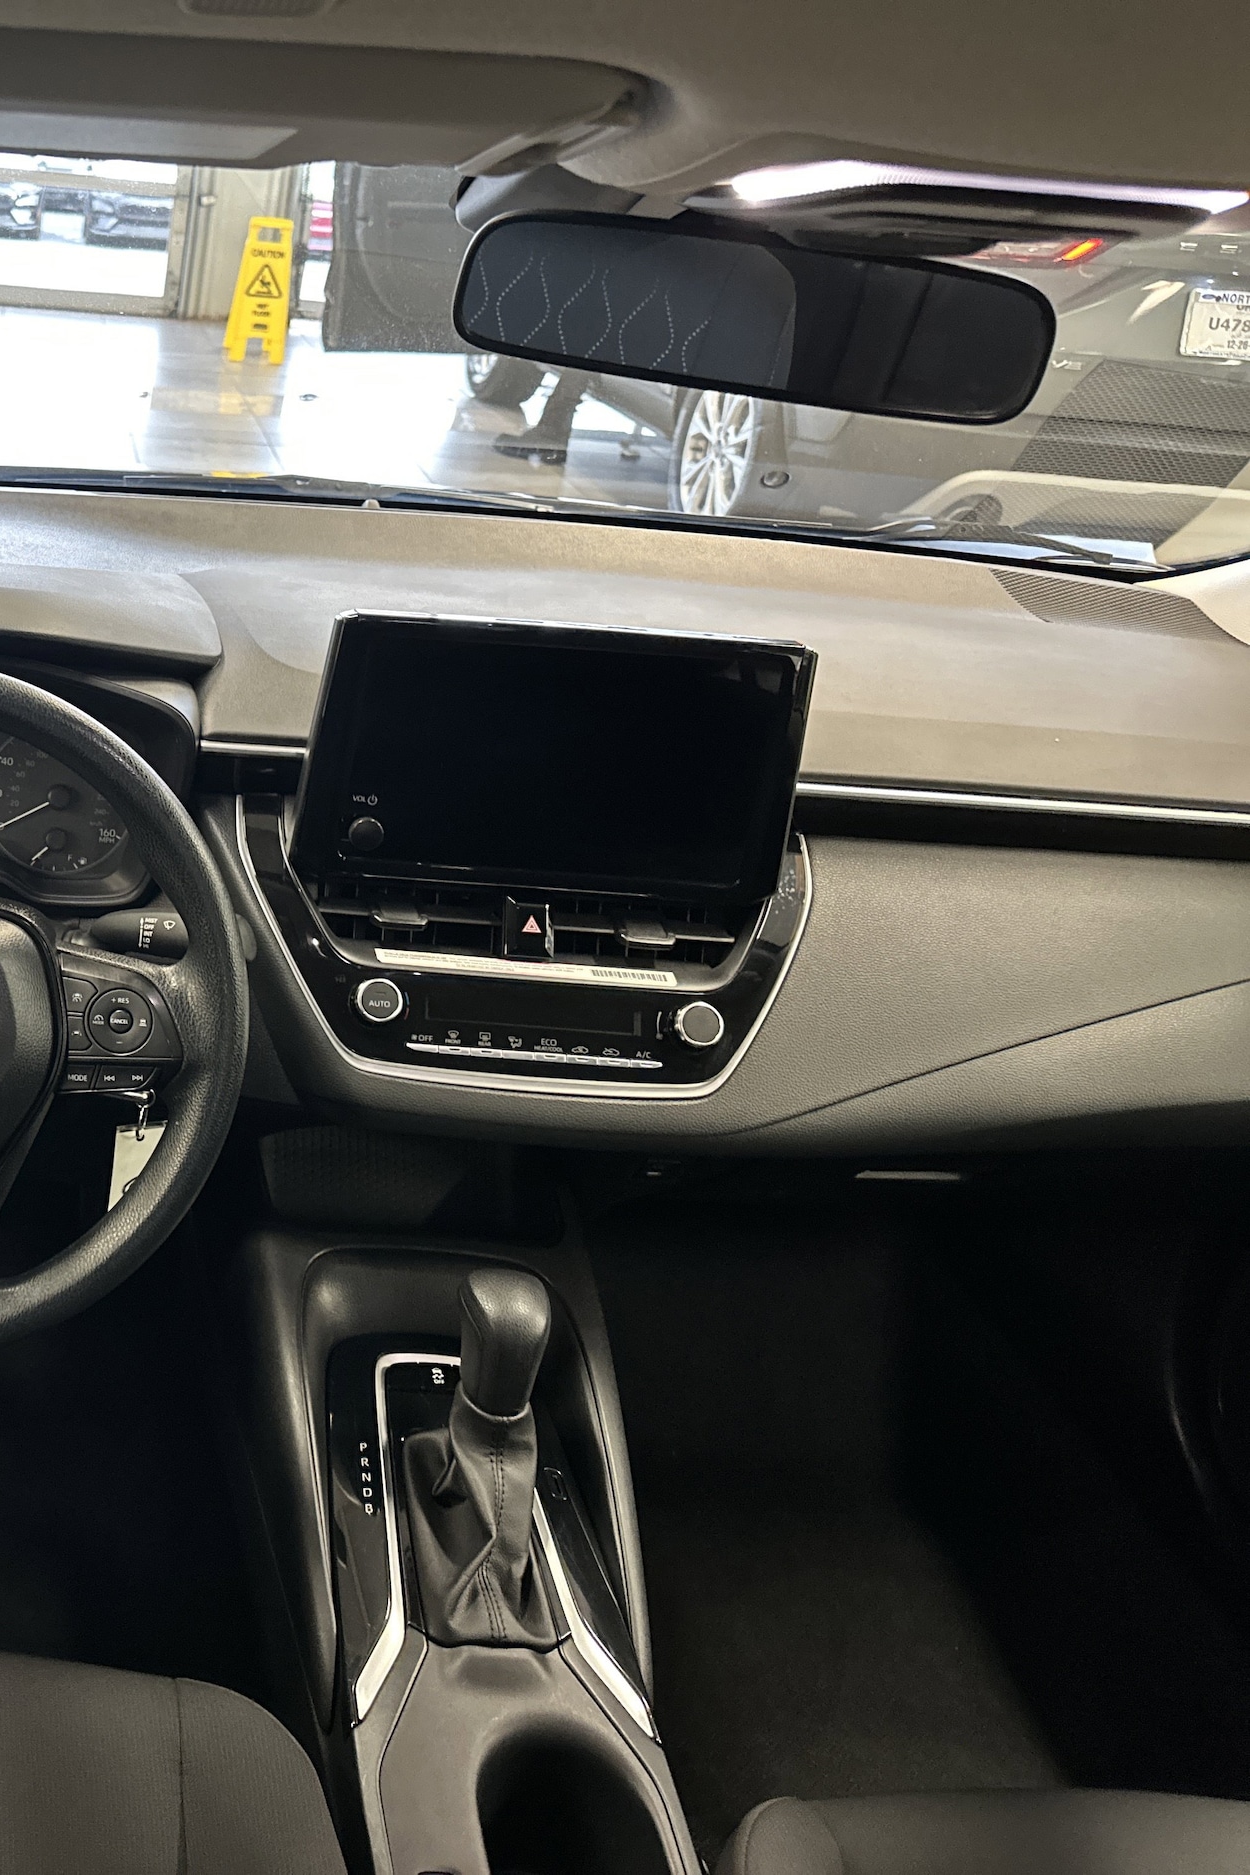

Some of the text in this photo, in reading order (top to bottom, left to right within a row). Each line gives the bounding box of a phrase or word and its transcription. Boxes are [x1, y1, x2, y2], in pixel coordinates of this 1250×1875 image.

[0, 757, 14, 766] 40
[99, 828, 116, 837] 160
[98, 836, 115, 844] MPH
[368, 999, 391, 1008] AUTO
[418, 1034, 434, 1042] OFF
[540, 1038, 558, 1047] ECO
[635, 1051, 652, 1059] A/C
[68, 1074, 88, 1082] MODE
[359, 1442, 368, 1452] P
[360, 1457, 370, 1467] R
[361, 1472, 372, 1482] N
[362, 1487, 373, 1498] D
